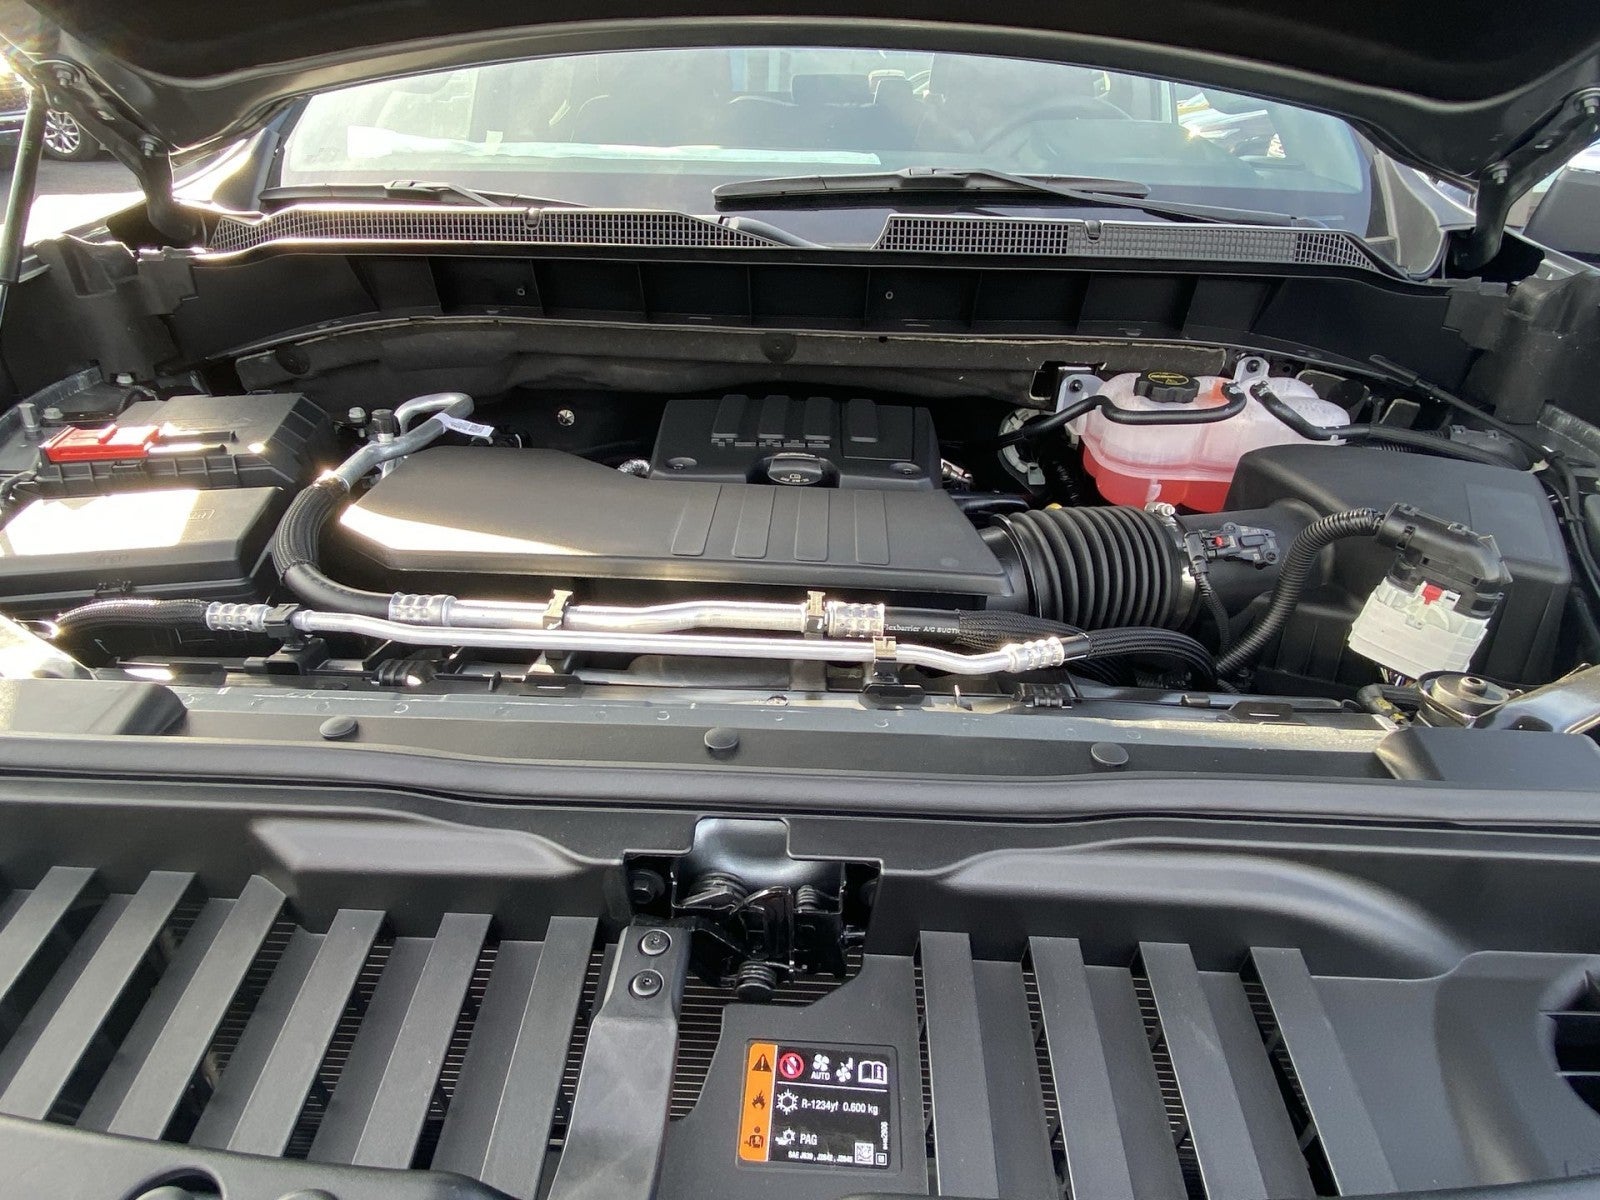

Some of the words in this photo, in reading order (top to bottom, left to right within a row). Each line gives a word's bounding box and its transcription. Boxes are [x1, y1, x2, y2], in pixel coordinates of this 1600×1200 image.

[923, 625, 935, 633] A/C
[810, 1070, 831, 1081] AUTO
[801, 1098, 839, 1113] R-1234yf
[842, 1101, 867, 1113] 0.600
[867, 1103, 879, 1116] kg
[799, 1133, 818, 1146] PAG
